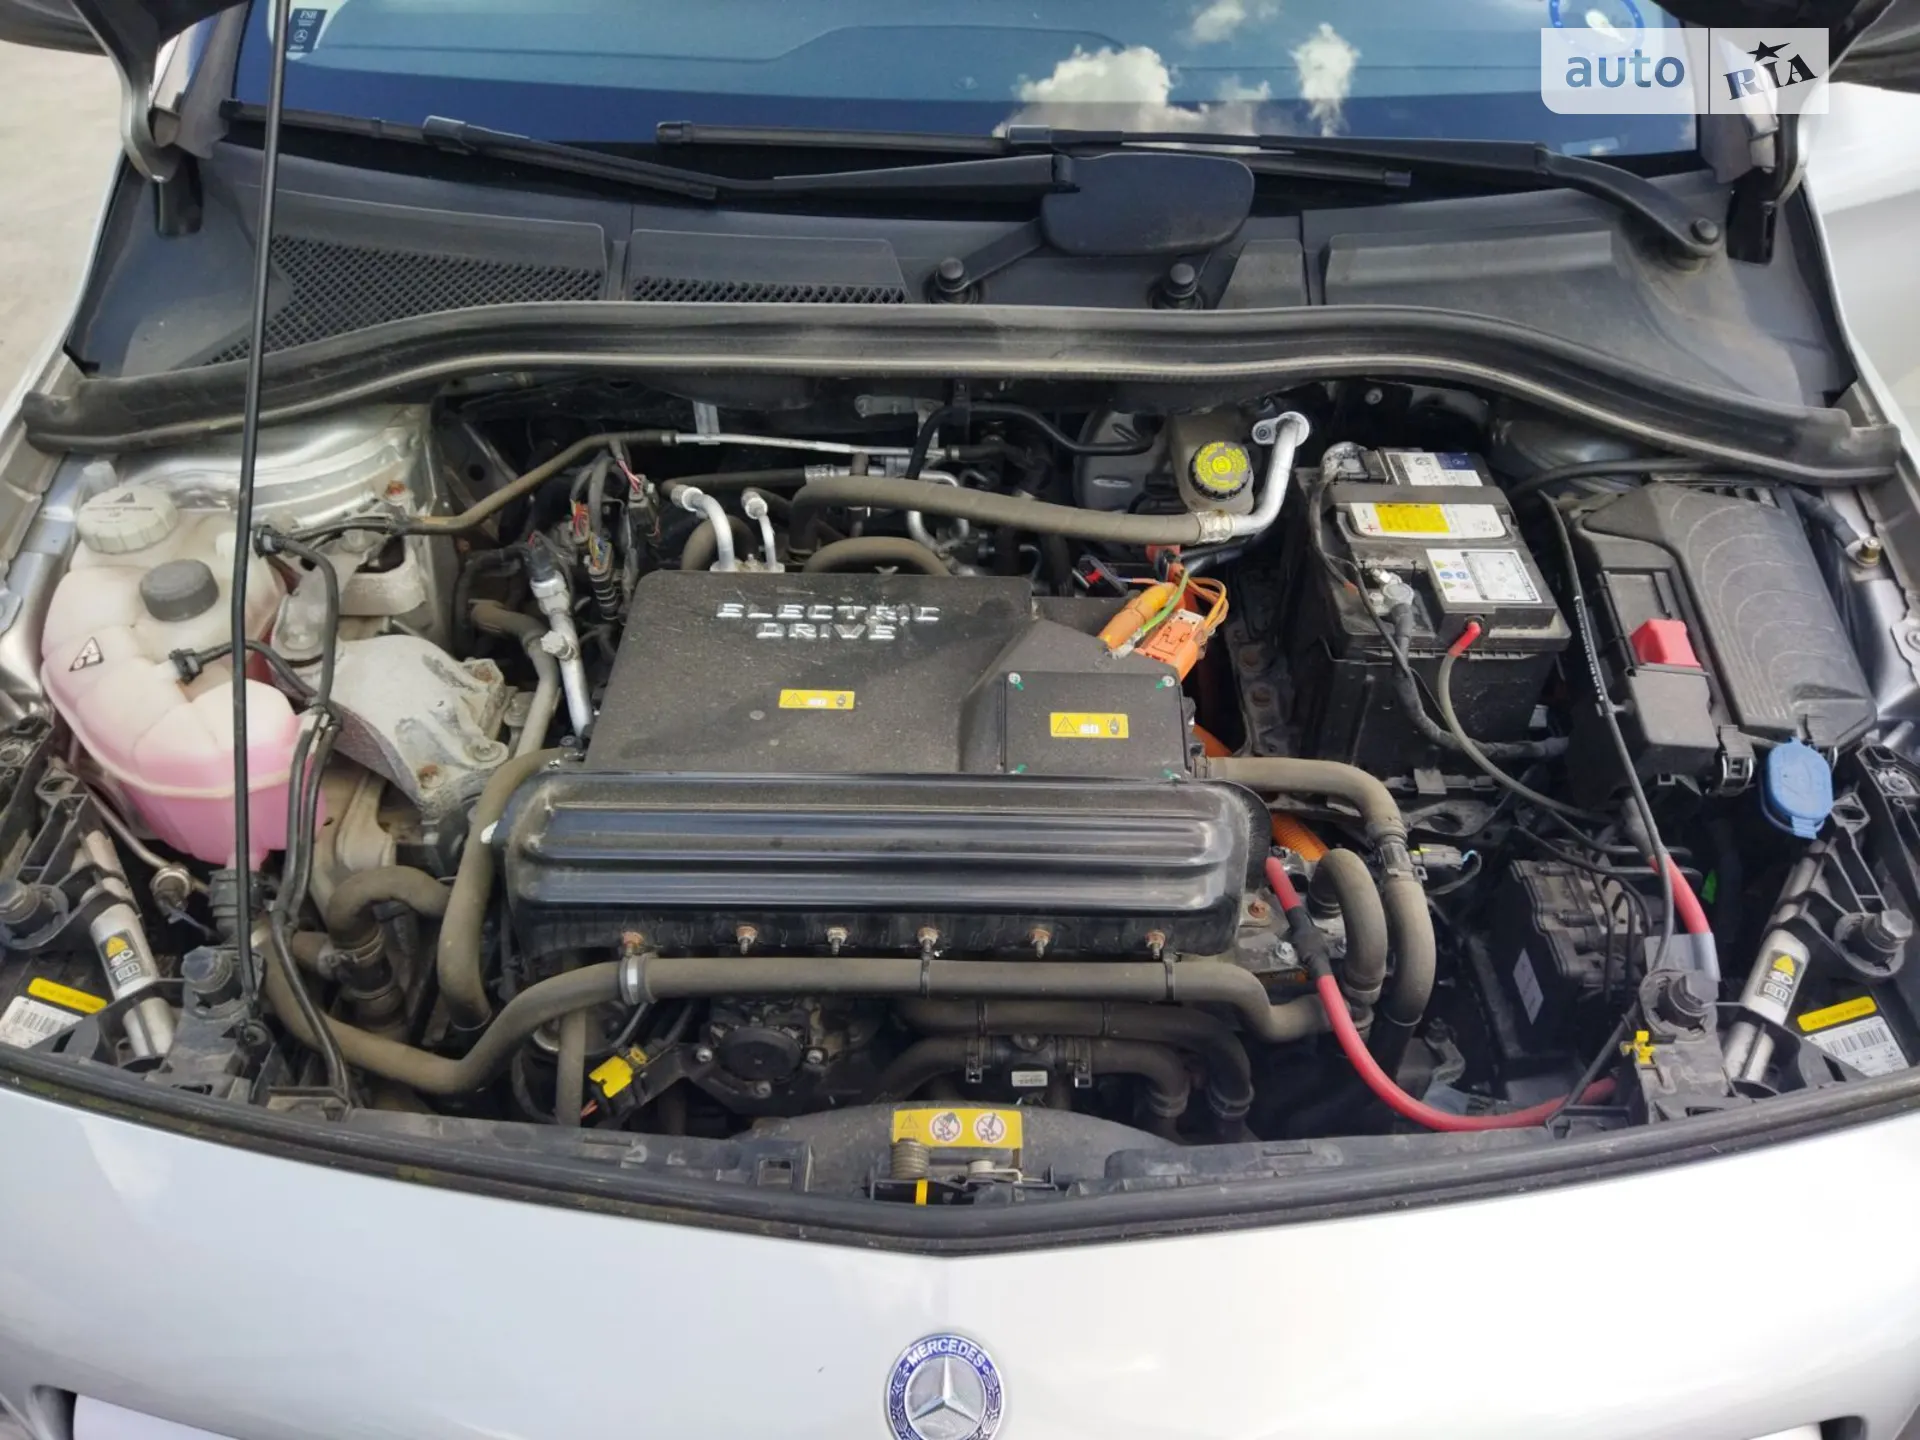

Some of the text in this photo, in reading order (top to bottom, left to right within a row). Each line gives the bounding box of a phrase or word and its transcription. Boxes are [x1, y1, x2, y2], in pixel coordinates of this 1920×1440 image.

[716, 603, 941, 623] ELECTRIC
[755, 622, 896, 640] DRIVE
[906, 1338, 987, 1368] MERCEDES
